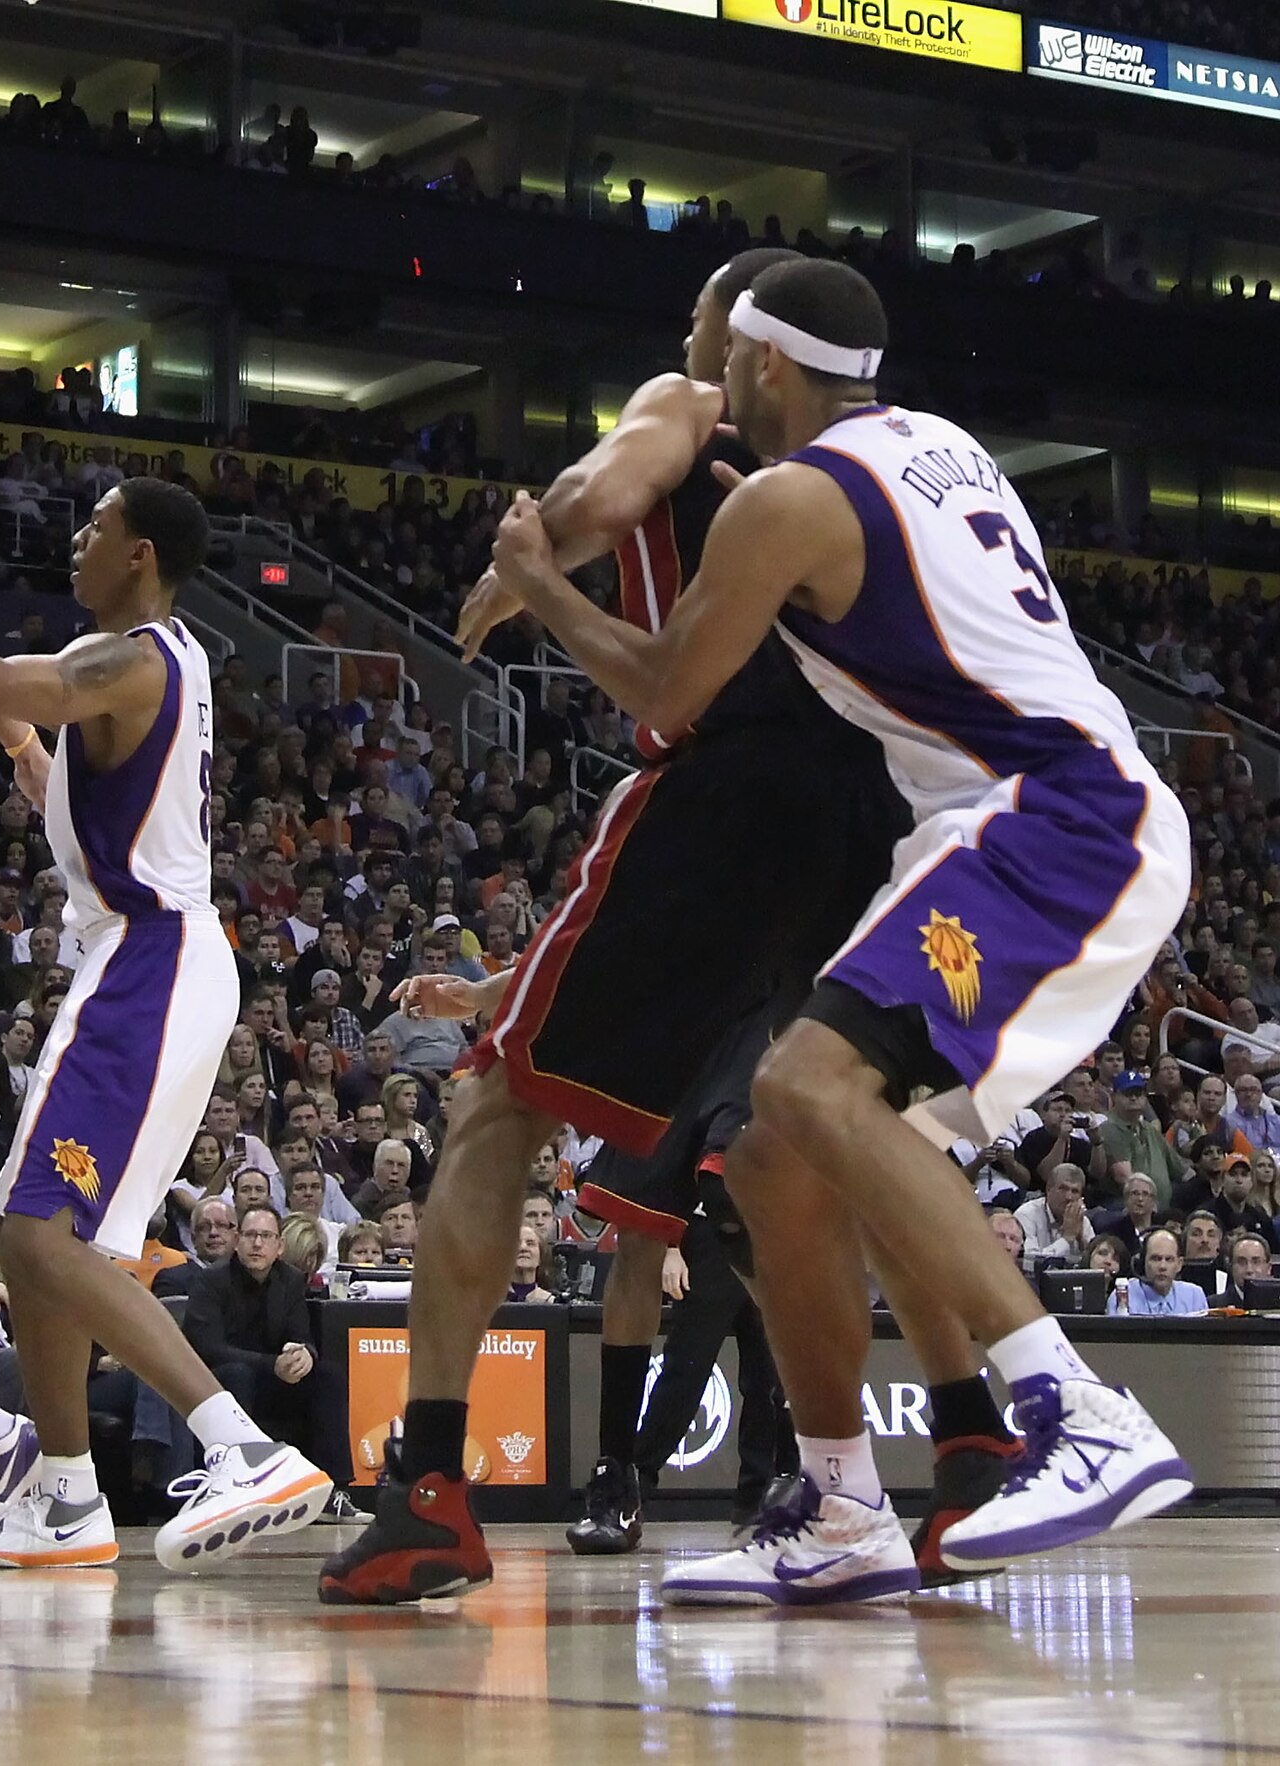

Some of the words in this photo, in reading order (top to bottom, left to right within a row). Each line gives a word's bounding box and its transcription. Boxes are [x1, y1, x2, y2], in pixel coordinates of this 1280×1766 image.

[831, 24, 840, 35] In
[843, 27, 882, 45] Identity
[885, 33, 911, 48] Theft
[915, 38, 970, 58] Protection
[1084, 34, 1144, 64] Wilson
[1085, 54, 1156, 86] Electric
[901, 448, 1005, 509] DUDLEY
[963, 509, 1061, 624] 3
